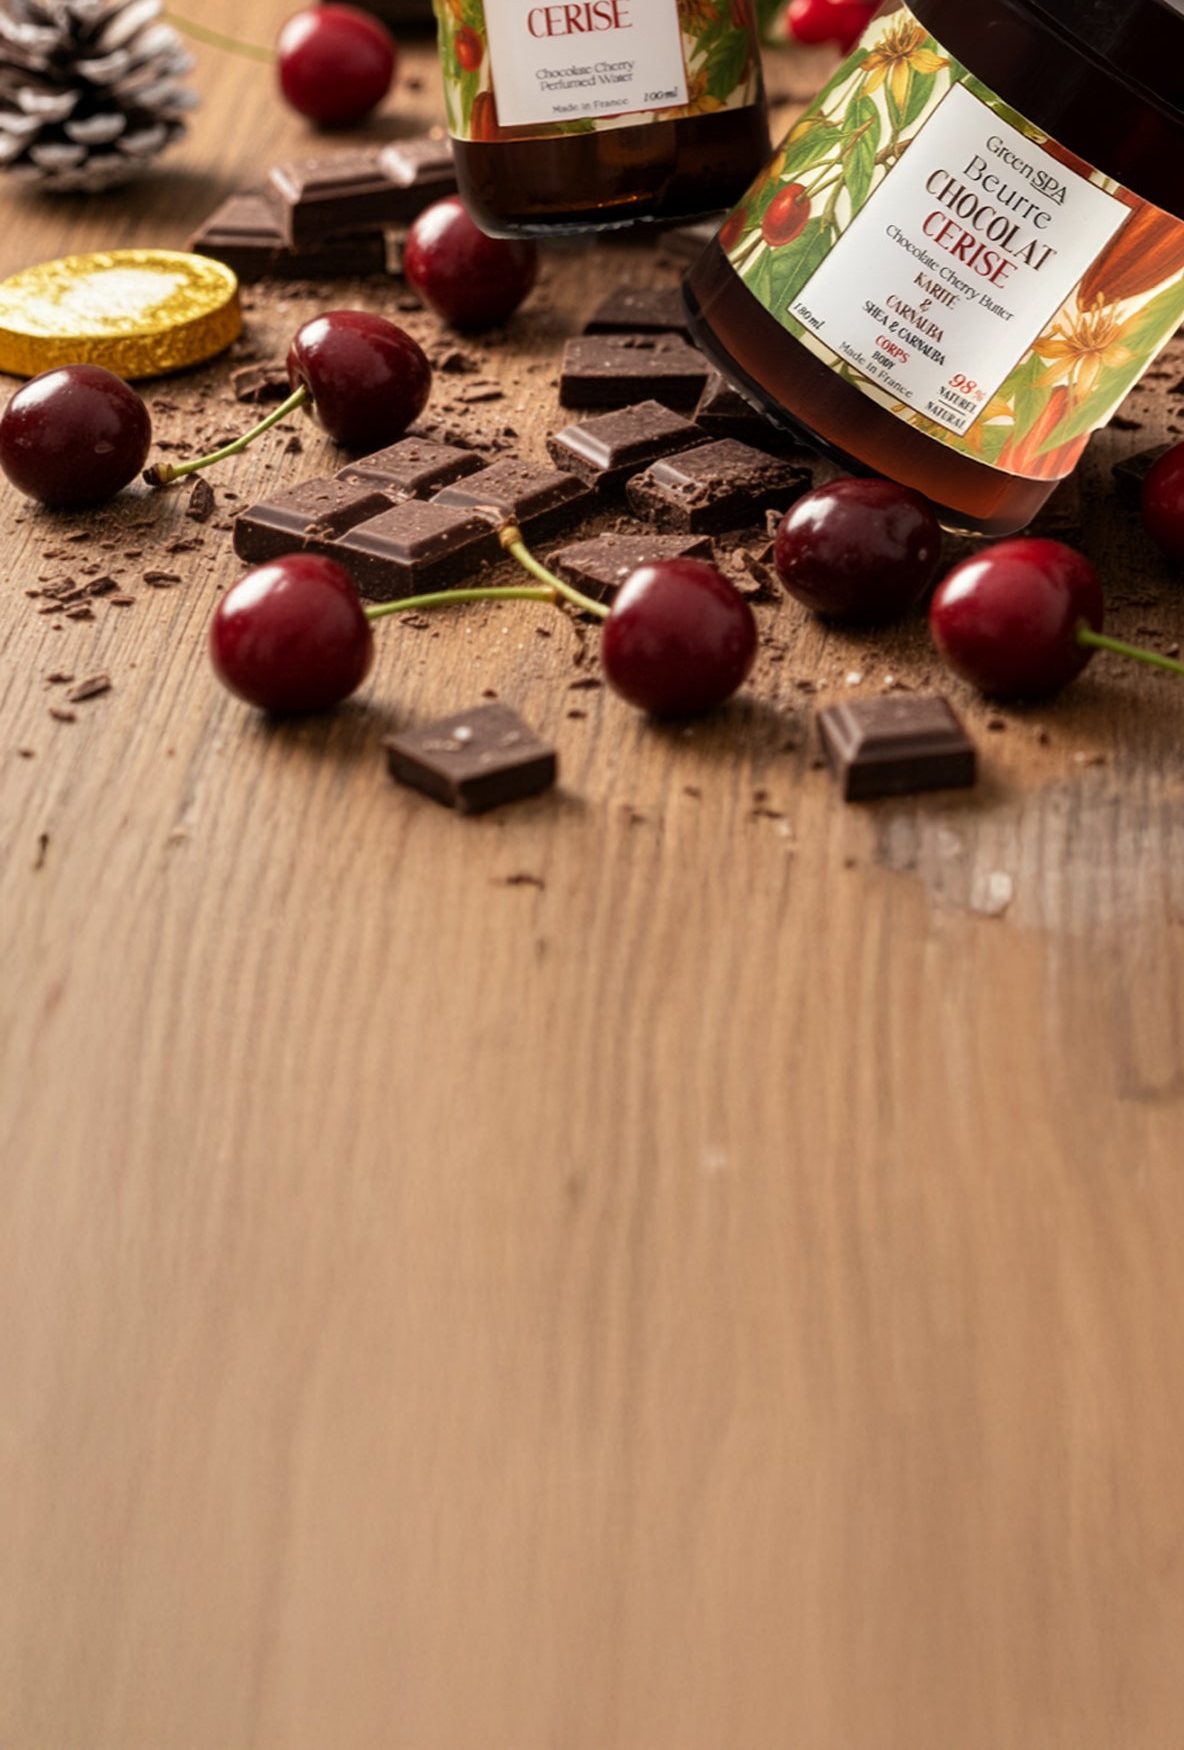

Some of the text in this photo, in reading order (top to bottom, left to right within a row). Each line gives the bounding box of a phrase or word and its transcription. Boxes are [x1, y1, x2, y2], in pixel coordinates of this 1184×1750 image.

[535, 60, 636, 80] Chocolate Cherry
[540, 72, 634, 92] Perfumed Water
[552, 97, 629, 114] Made in France
[962, 154, 1052, 230] Beurre
[925, 169, 1058, 271] CHOCOLAT
[922, 210, 1019, 289] CERISE
[885, 224, 1015, 322] Chocolate Cherry Butter
[913, 271, 961, 310] KARITÉ
[918, 298, 933, 314] &
[863, 300, 946, 366] SHEA & CARNAUBA
[886, 294, 944, 344] CARNAUBA
[871, 350, 896, 370] BODY
[875, 334, 911, 364] CORPS
[838, 341, 914, 399] Made in France
[924, 400, 967, 430] NATURAL
[939, 385, 977, 414] NATUREL
